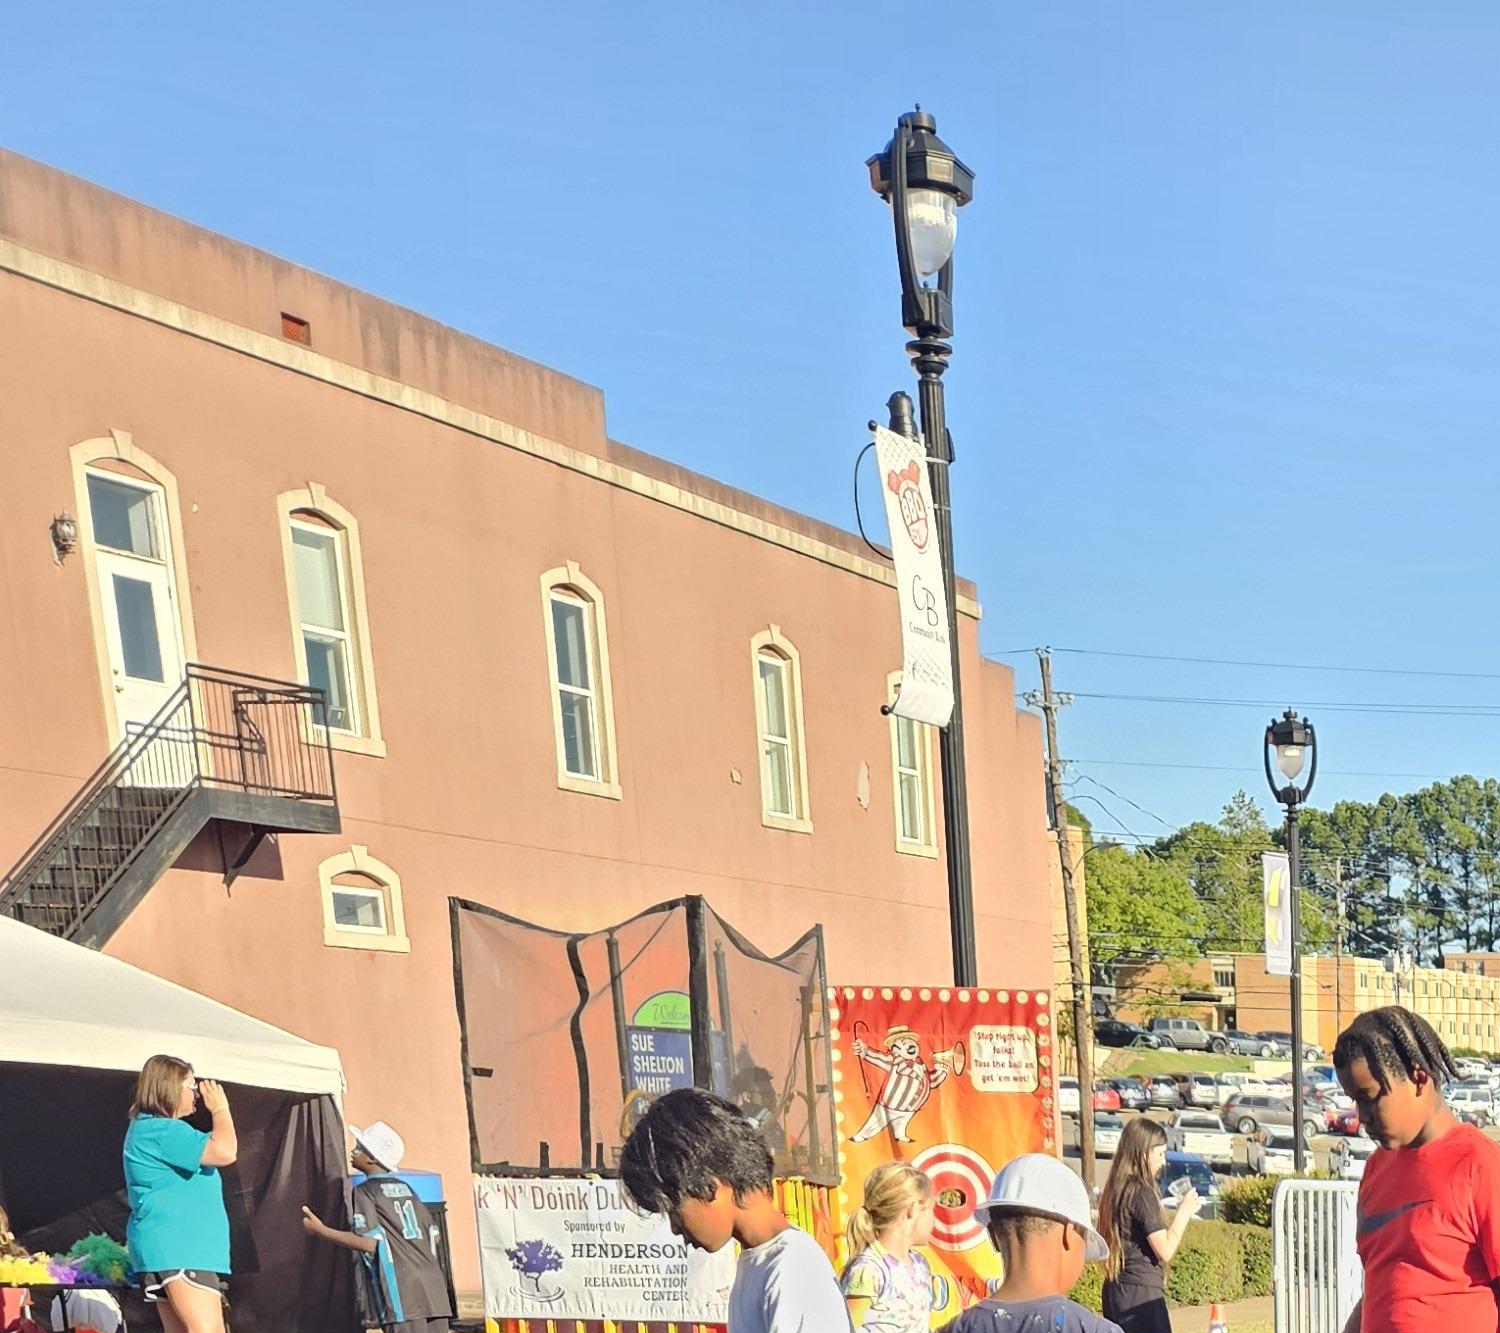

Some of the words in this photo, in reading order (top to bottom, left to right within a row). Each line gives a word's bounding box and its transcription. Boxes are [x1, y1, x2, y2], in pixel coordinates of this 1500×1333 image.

[631, 1034, 655, 1052] SUE
[977, 1032, 994, 1041] Step
[996, 1033, 1015, 1043] right
[633, 1055, 684, 1074] SHELTON
[974, 1060, 990, 1068] Toss
[992, 1060, 1006, 1069] the
[1008, 1060, 1023, 1069] ball
[635, 1076, 672, 1095] WHITE
[981, 1074, 994, 1084] get
[531, 1183, 589, 1210] Doink
[393, 1199, 423, 1240] 11
[564, 1220, 611, 1233] Sponsored
[614, 1220, 626, 1233] by
[571, 1243, 688, 1259] HENDERSON
[609, 1264, 660, 1274] HEALTH
[665, 1264, 688, 1275] AND
[584, 1277, 687, 1288] REHABILITATION
[642, 1291, 689, 1301] CENTER
